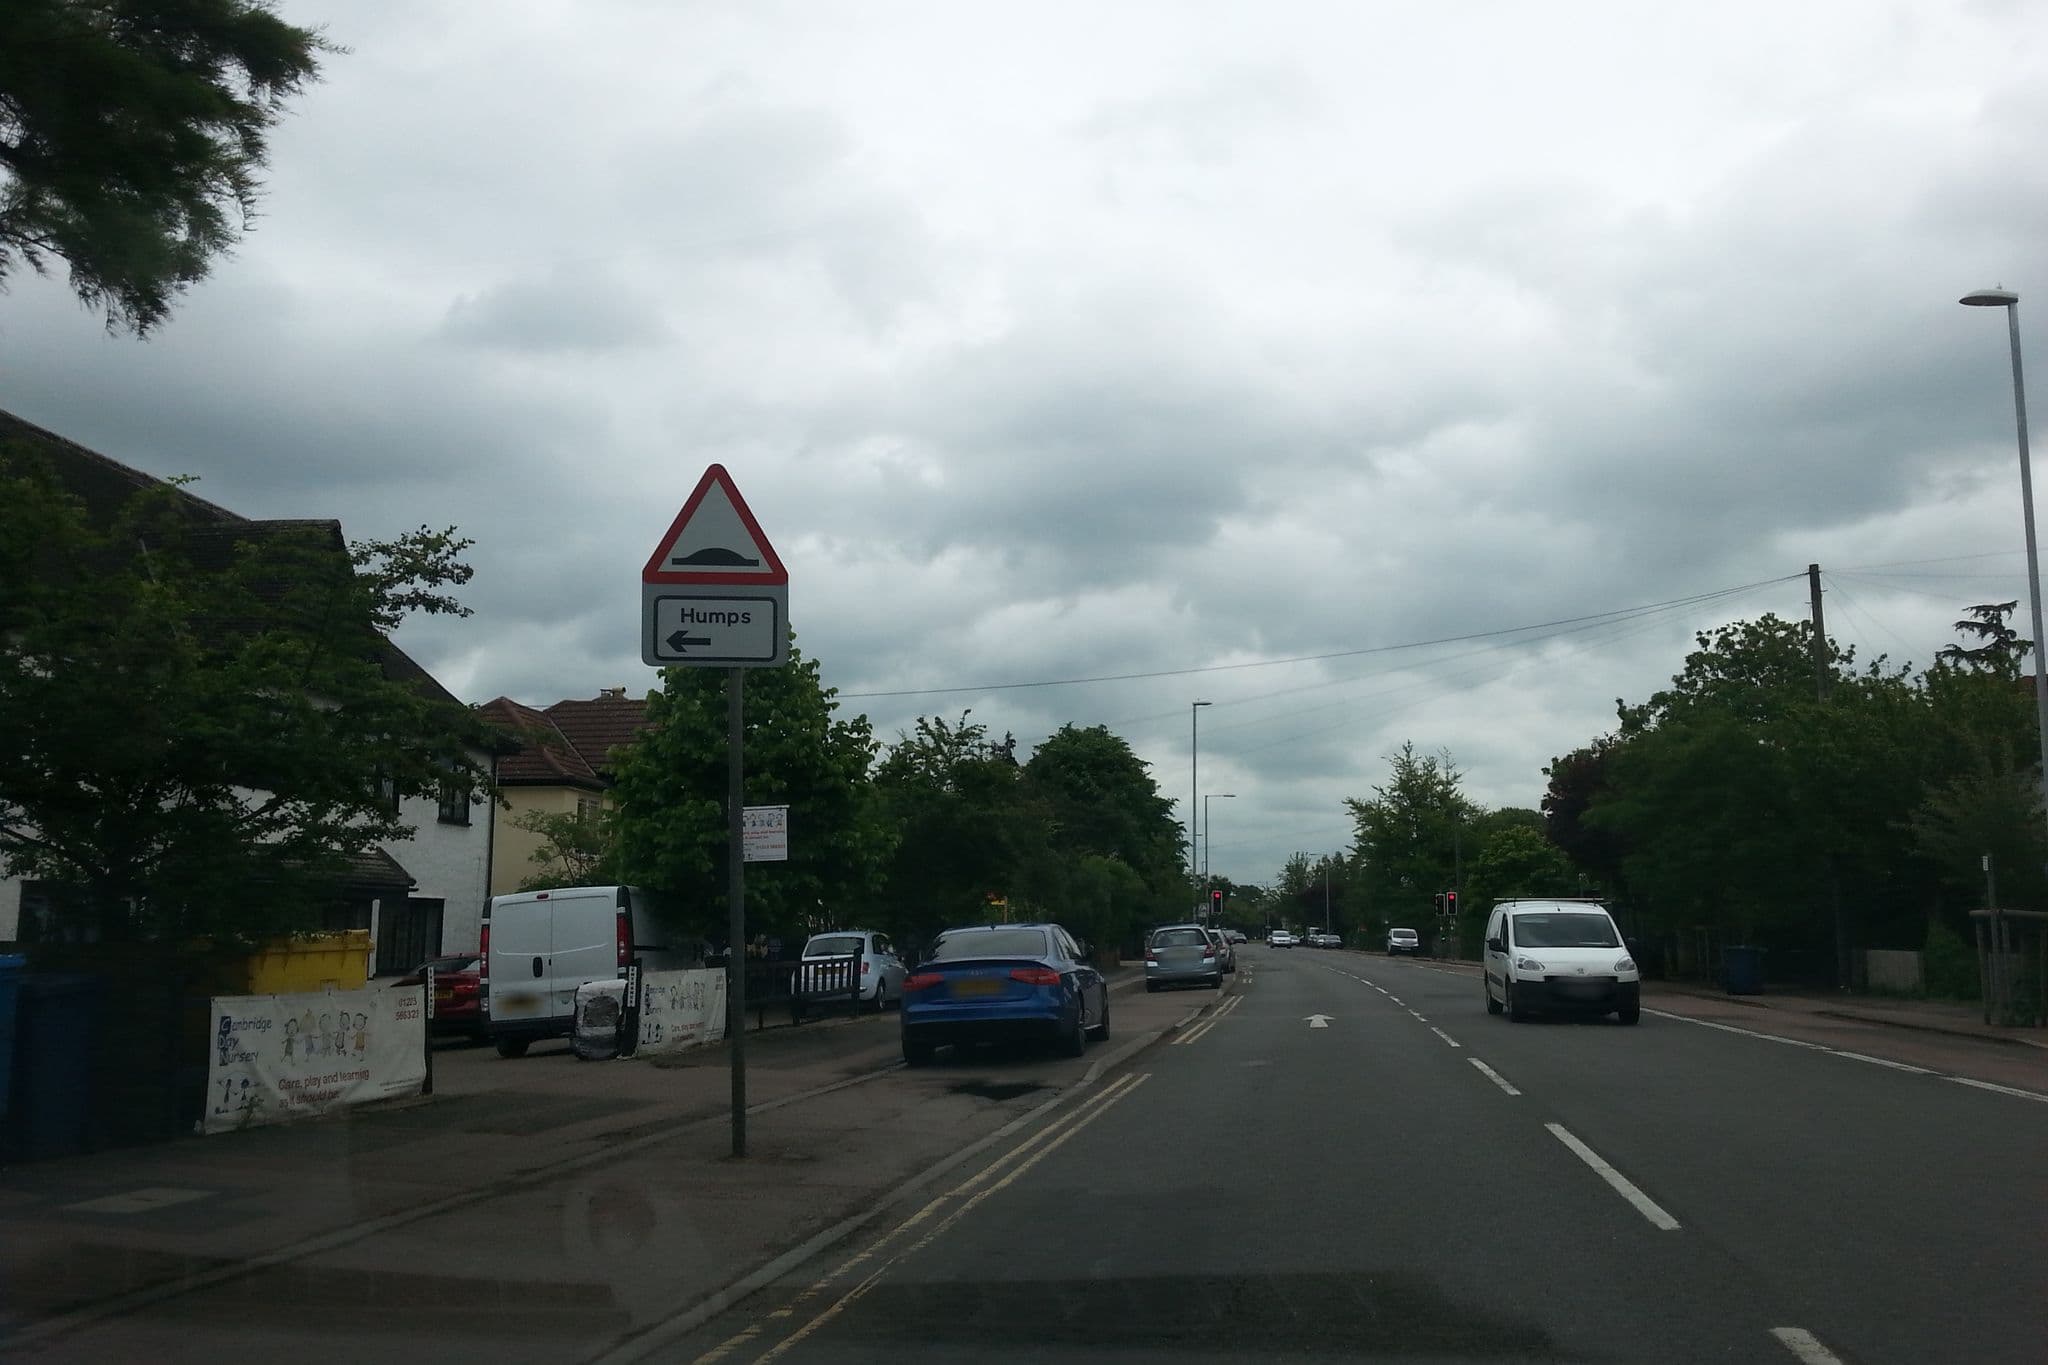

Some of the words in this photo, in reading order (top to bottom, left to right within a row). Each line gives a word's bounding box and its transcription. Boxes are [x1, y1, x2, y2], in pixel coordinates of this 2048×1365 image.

[681, 608, 751, 627] Humps
[220, 1016, 272, 1032] Cambridge
[218, 1034, 239, 1051] Day
[219, 1048, 259, 1065] Nursery
[304, 1075, 321, 1089] play
[322, 1072, 338, 1084] and
[339, 1068, 369, 1081] learning
